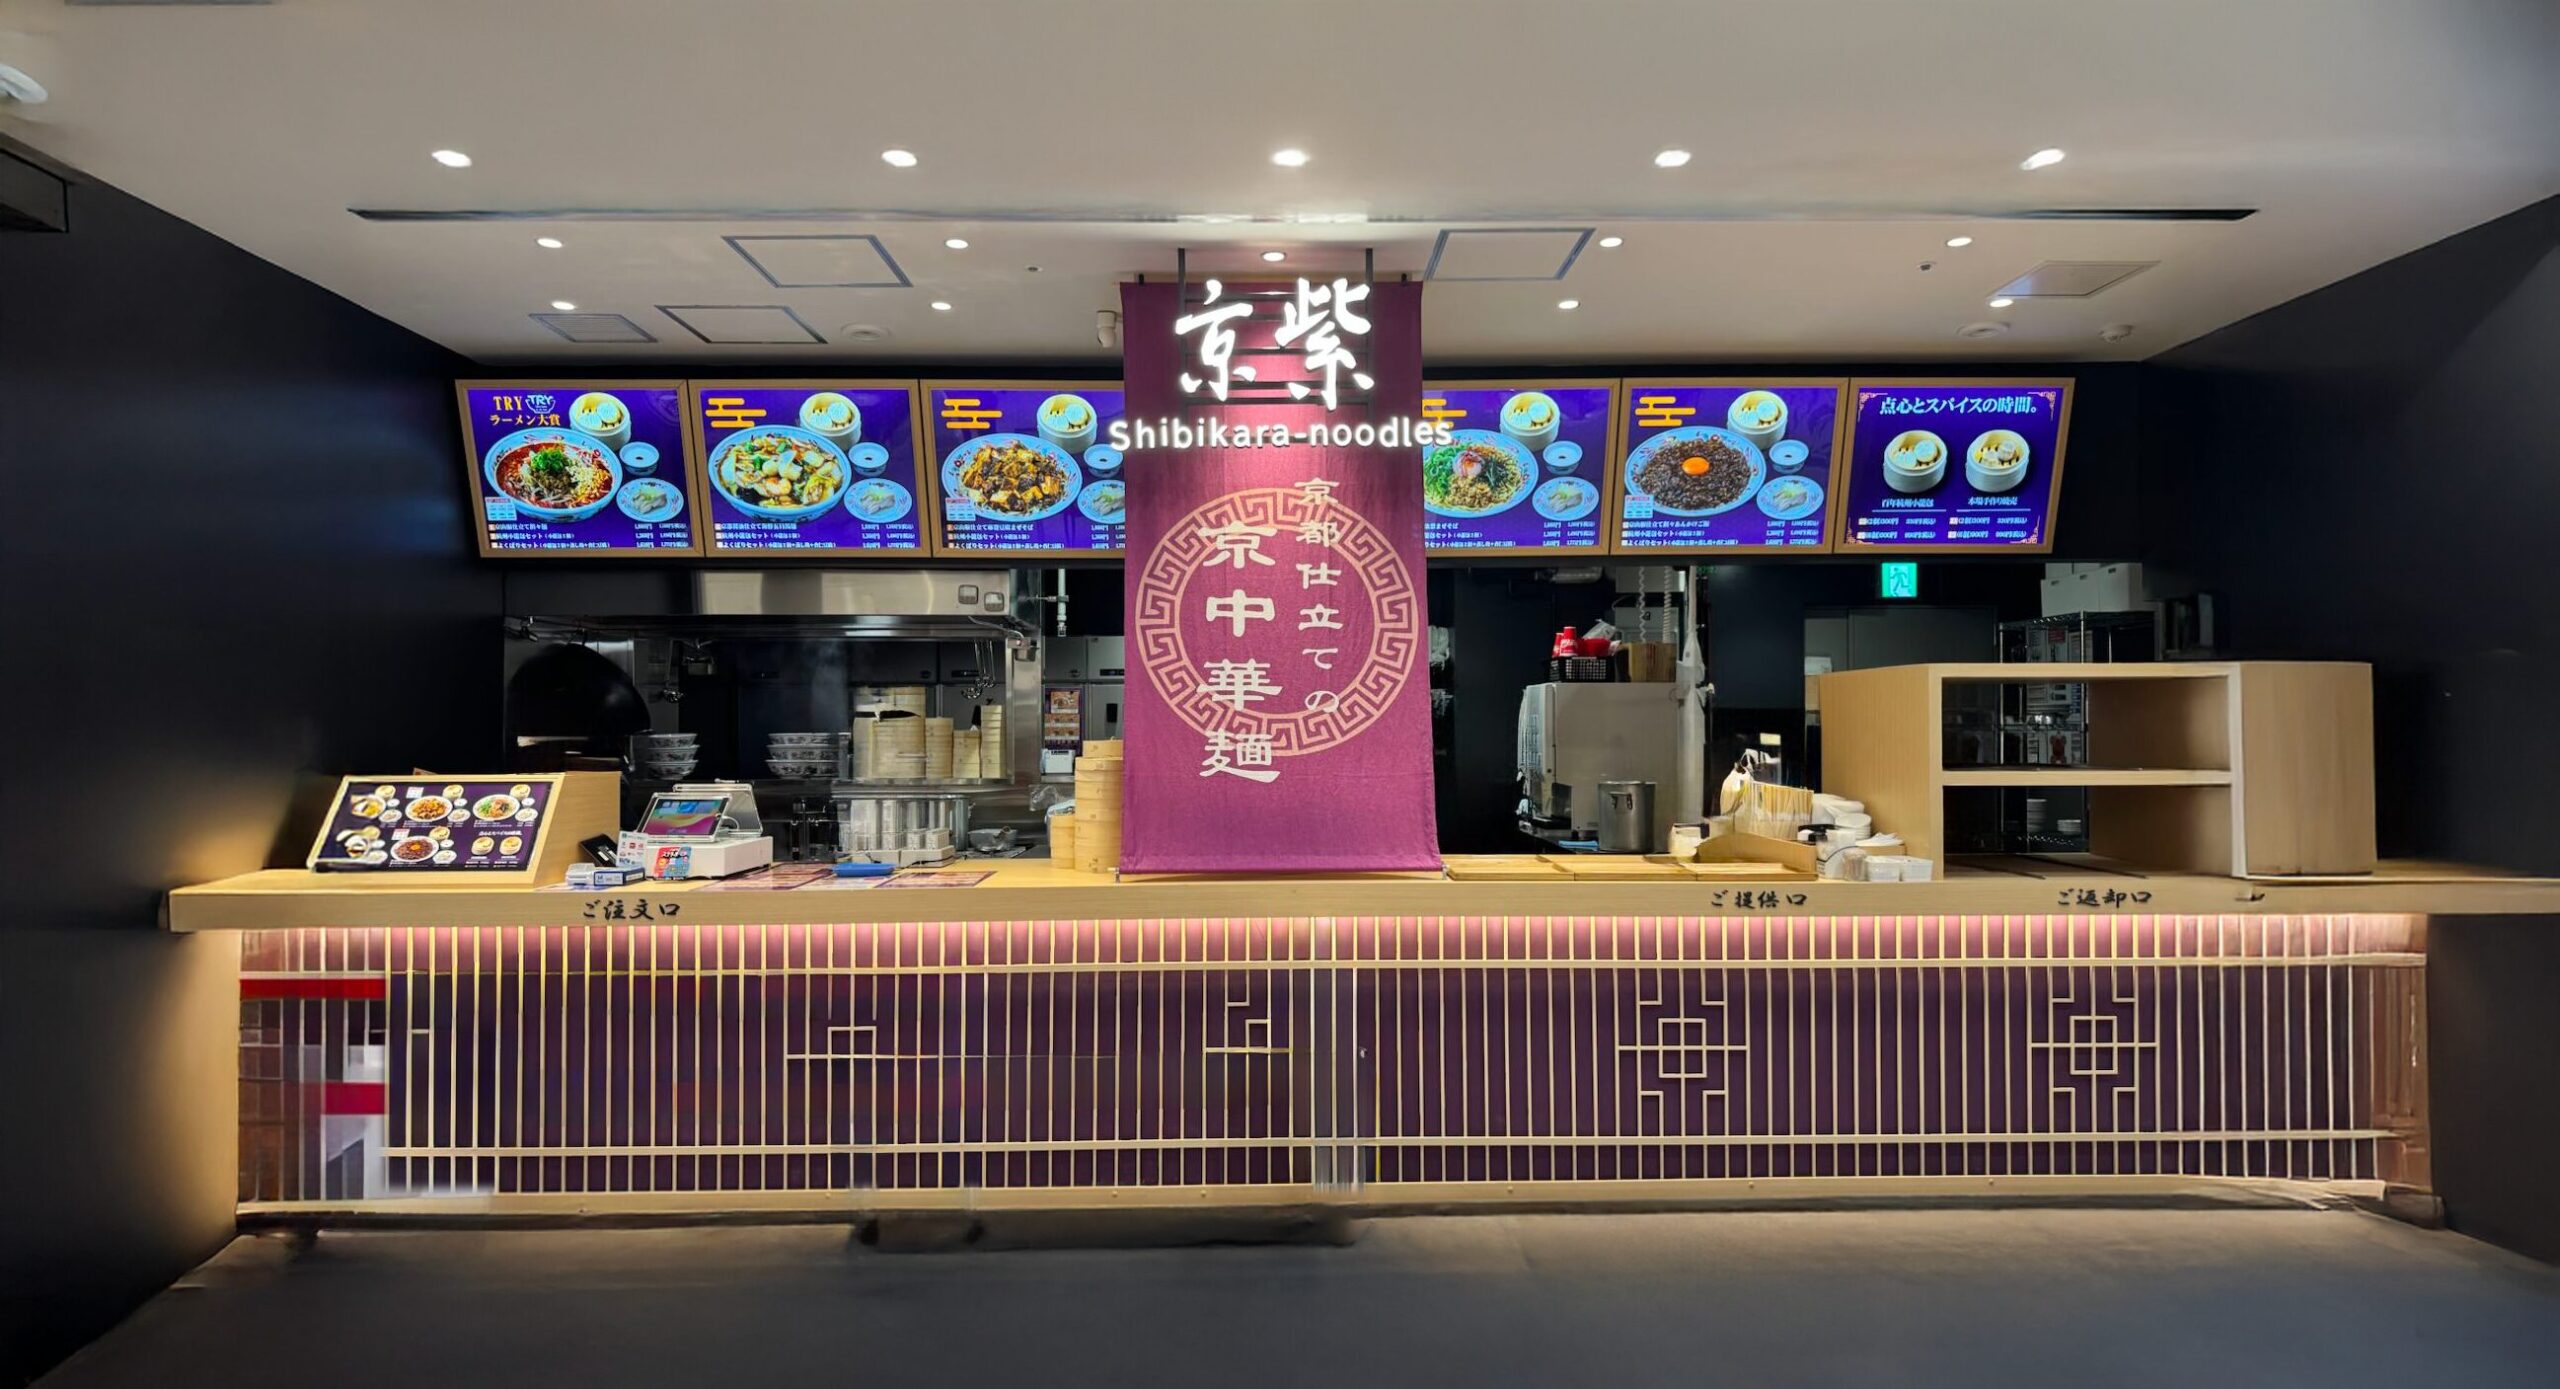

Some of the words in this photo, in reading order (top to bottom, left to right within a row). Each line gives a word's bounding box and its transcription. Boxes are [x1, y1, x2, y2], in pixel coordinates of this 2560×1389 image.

[1175, 277, 1375, 411] 京紫
[493, 395, 523, 412] TRY
[1879, 396, 2037, 415] 点心とスパイスの時間。
[489, 413, 561, 427] ラーメン大賞
[1109, 417, 1453, 451] Shibikara-noodles
[1294, 477, 1344, 714] 京都仕立ての
[1197, 520, 1284, 784] 京中華麺
[583, 898, 681, 921] ご注文口
[1710, 889, 1809, 909] ご提供口
[2056, 888, 2154, 909] ご返却口
